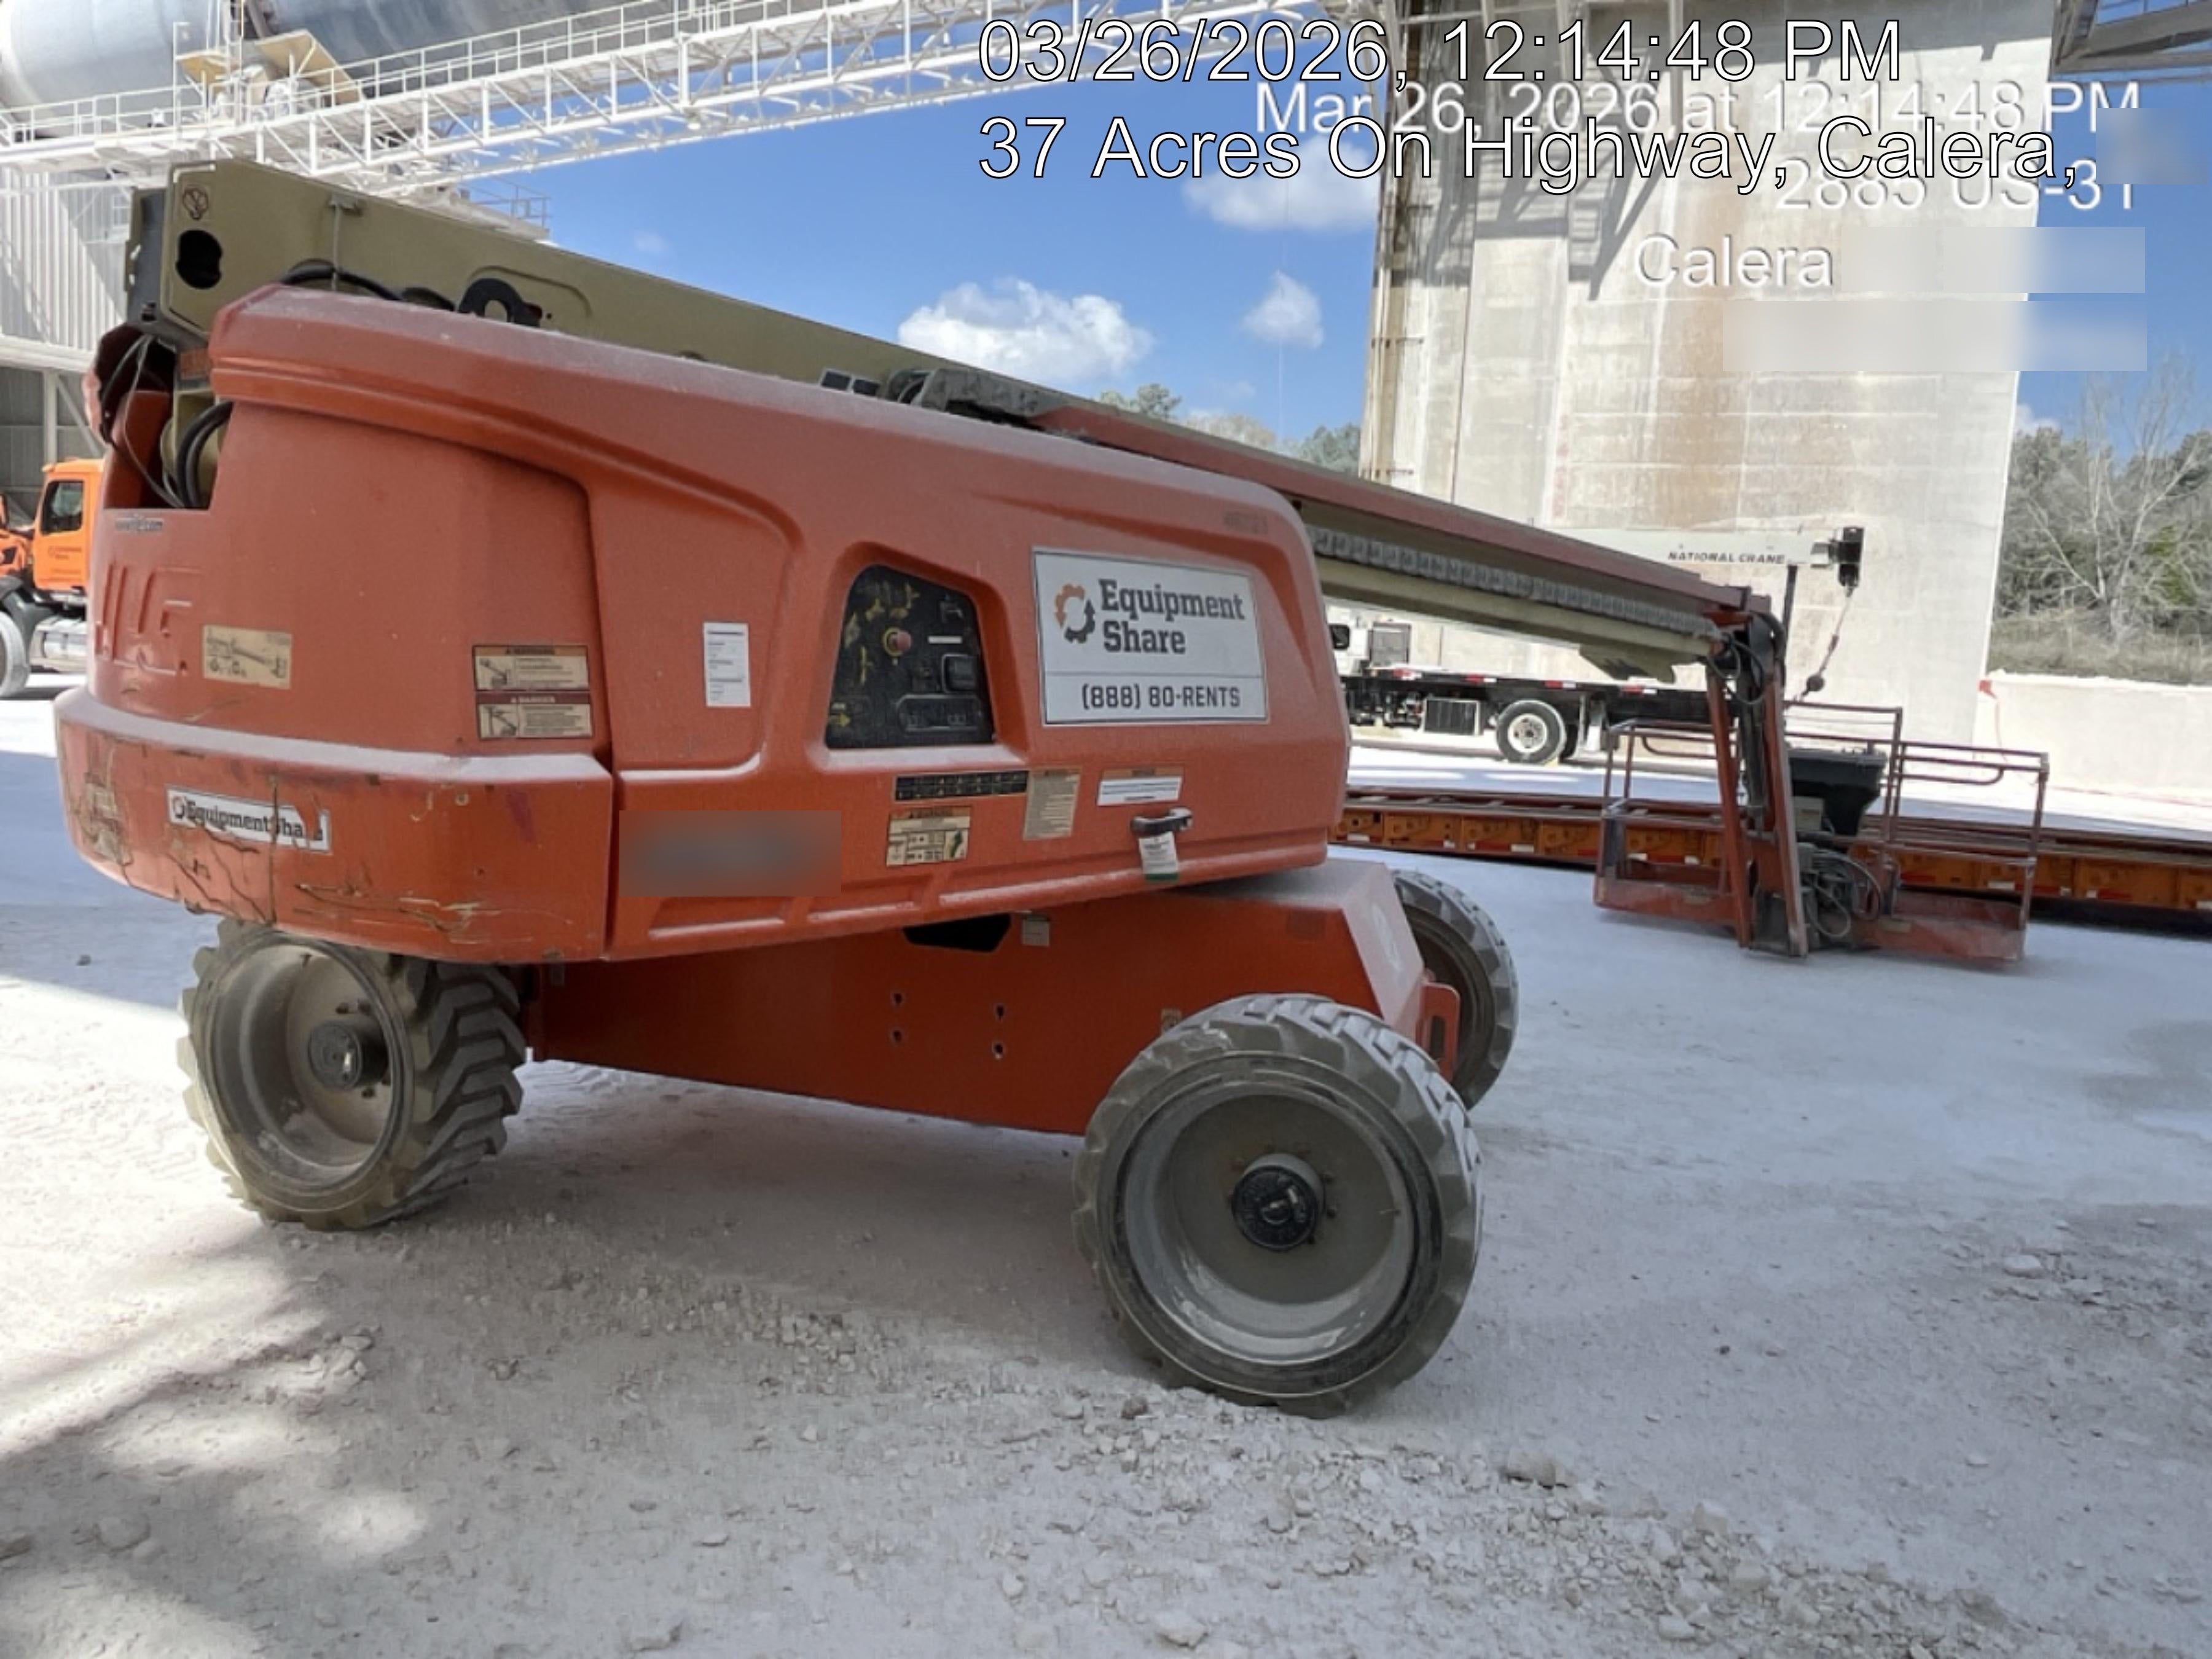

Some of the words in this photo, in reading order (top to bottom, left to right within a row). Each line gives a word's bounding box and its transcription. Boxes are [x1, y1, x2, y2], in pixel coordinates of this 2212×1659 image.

[1668, 551, 1735, 562] NATIONAL
[1738, 554, 1786, 564] CRANE
[1099, 579, 1245, 622] Equipment
[1103, 621, 1186, 654] Share
[1081, 683, 1140, 710] (888)
[1148, 686, 1241, 707] 80-RENTS
